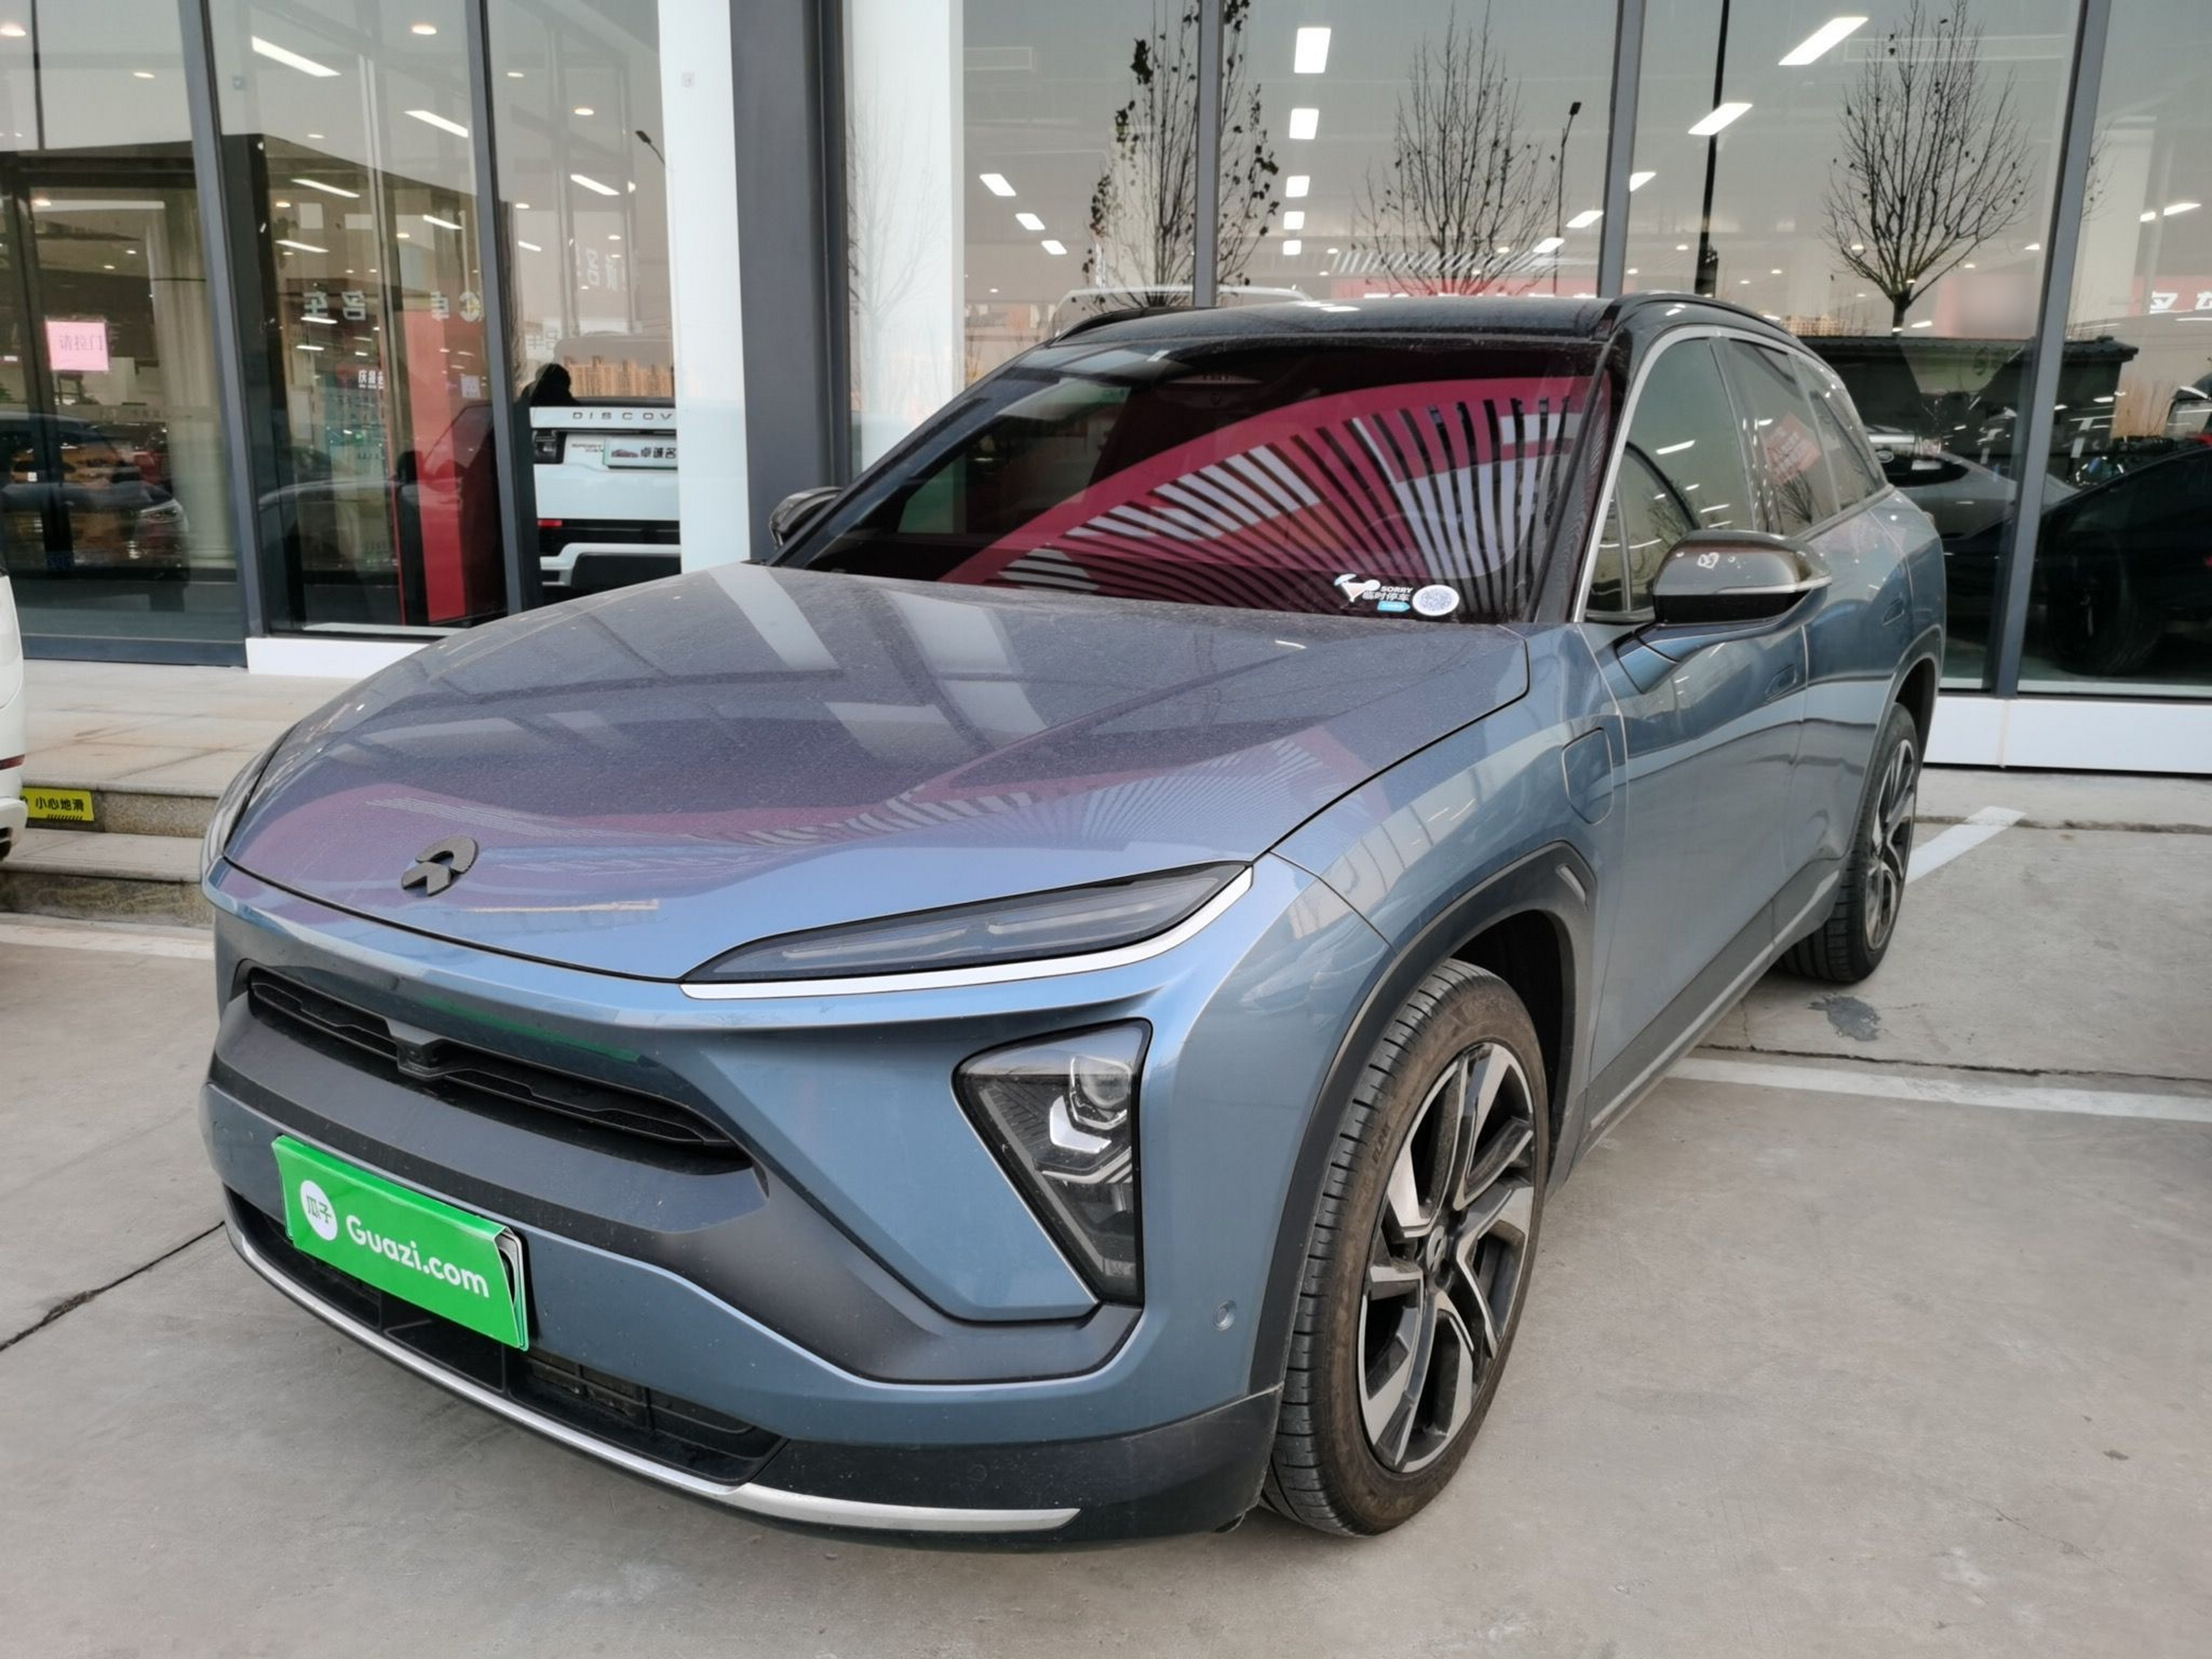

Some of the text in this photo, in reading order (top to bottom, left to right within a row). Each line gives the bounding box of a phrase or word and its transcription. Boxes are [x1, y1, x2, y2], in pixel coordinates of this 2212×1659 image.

[59, 334, 104, 351] 请拉门
[36, 796, 84, 812] 小心地滑
[305, 1195, 332, 1224] 瓜子
[346, 1215, 490, 1298] Guazi.com
